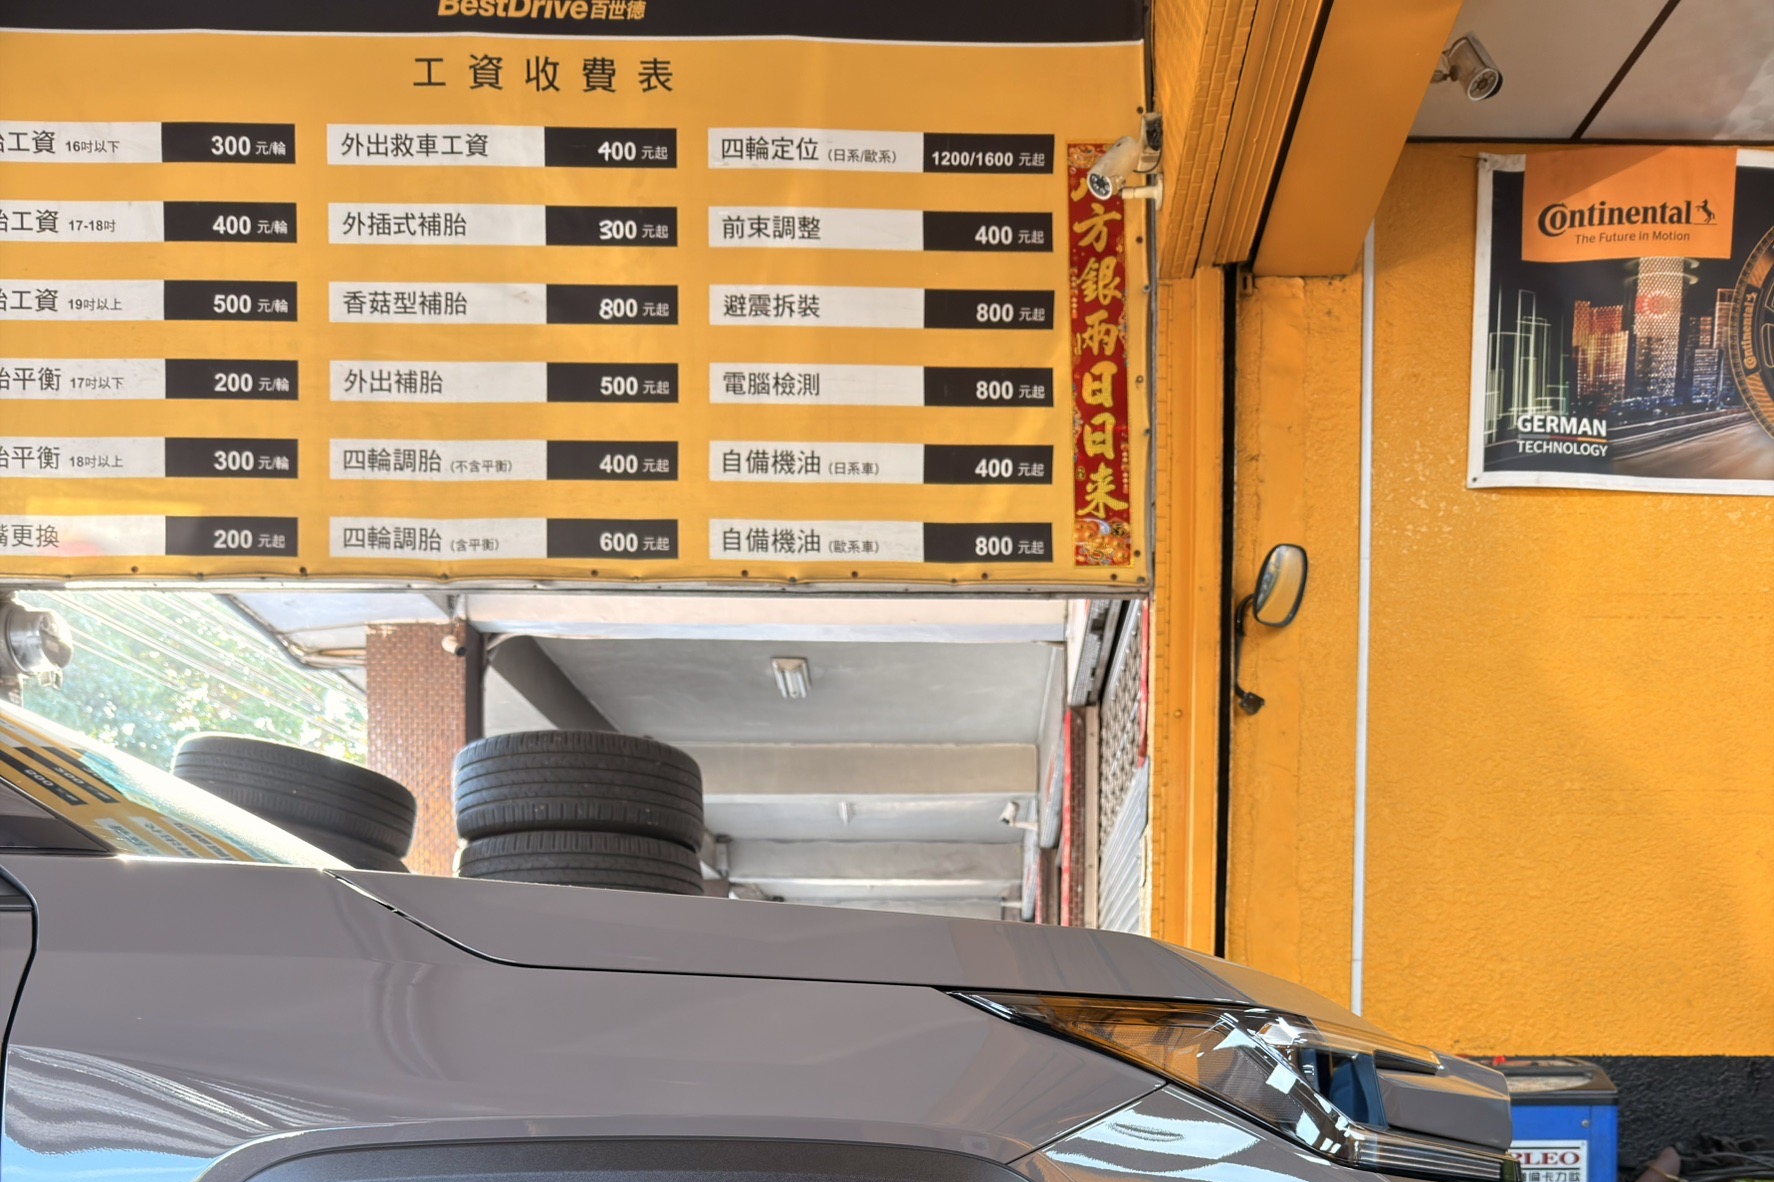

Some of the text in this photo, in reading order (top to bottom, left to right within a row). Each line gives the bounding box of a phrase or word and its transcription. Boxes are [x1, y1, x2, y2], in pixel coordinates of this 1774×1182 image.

[437, 0, 647, 20] BestDrive 百世德
[413, 54, 673, 93] 工資收費表
[65, 140, 120, 154] 16吋以下
[211, 135, 251, 156] 300
[255, 141, 286, 156] 元/輪
[341, 132, 668, 162] 外出救車工資 400 元起
[721, 136, 819, 161] 四輪定位
[932, 151, 1014, 167] 1200/1600
[1018, 152, 1045, 167] 元起
[68, 219, 116, 233] 17-18吋
[212, 215, 252, 235] 400
[257, 220, 288, 235] 元/輪
[342, 211, 669, 240] 外插式補胎 300 元起
[722, 215, 1045, 245] 前束調整 400 元起
[1538, 201, 1692, 237] Continental
[1576, 231, 1690, 245] The Future in Motion
[68, 297, 122, 312] 19吋以上
[213, 294, 252, 314] 500
[257, 298, 289, 313] 元/輪
[343, 290, 670, 320] 香菇型補胎 800 元起
[723, 293, 1046, 323] 避震拆裝 800 元起
[70, 376, 124, 390] 17吋以下
[214, 372, 253, 393] 200
[258, 377, 290, 392] 元/輪
[344, 369, 670, 396] 外出補胎 500 元起
[723, 371, 1046, 400] 電腦檢測 800 元起
[1517, 415, 1608, 437] GERMAN
[69, 455, 124, 469] 18吋以上
[213, 450, 255, 471] 300
[258, 456, 290, 470] 元/輪
[343, 447, 442, 473] 四輪調胎
[599, 454, 639, 474] 400
[642, 458, 670, 473] 元起
[1517, 440, 1608, 457] TECHNOLOGY
[722, 449, 821, 475] 自備機油
[974, 458, 1013, 478] 400
[1017, 462, 1045, 477] 元起
[213, 529, 253, 549] 200
[258, 533, 286, 549] 元起
[343, 525, 442, 552] 四輪調胎
[599, 532, 639, 553] 600
[642, 536, 670, 551] 元起
[723, 527, 821, 554] 自備機油
[975, 536, 1013, 556] 800
[1018, 540, 1045, 555] 元起
